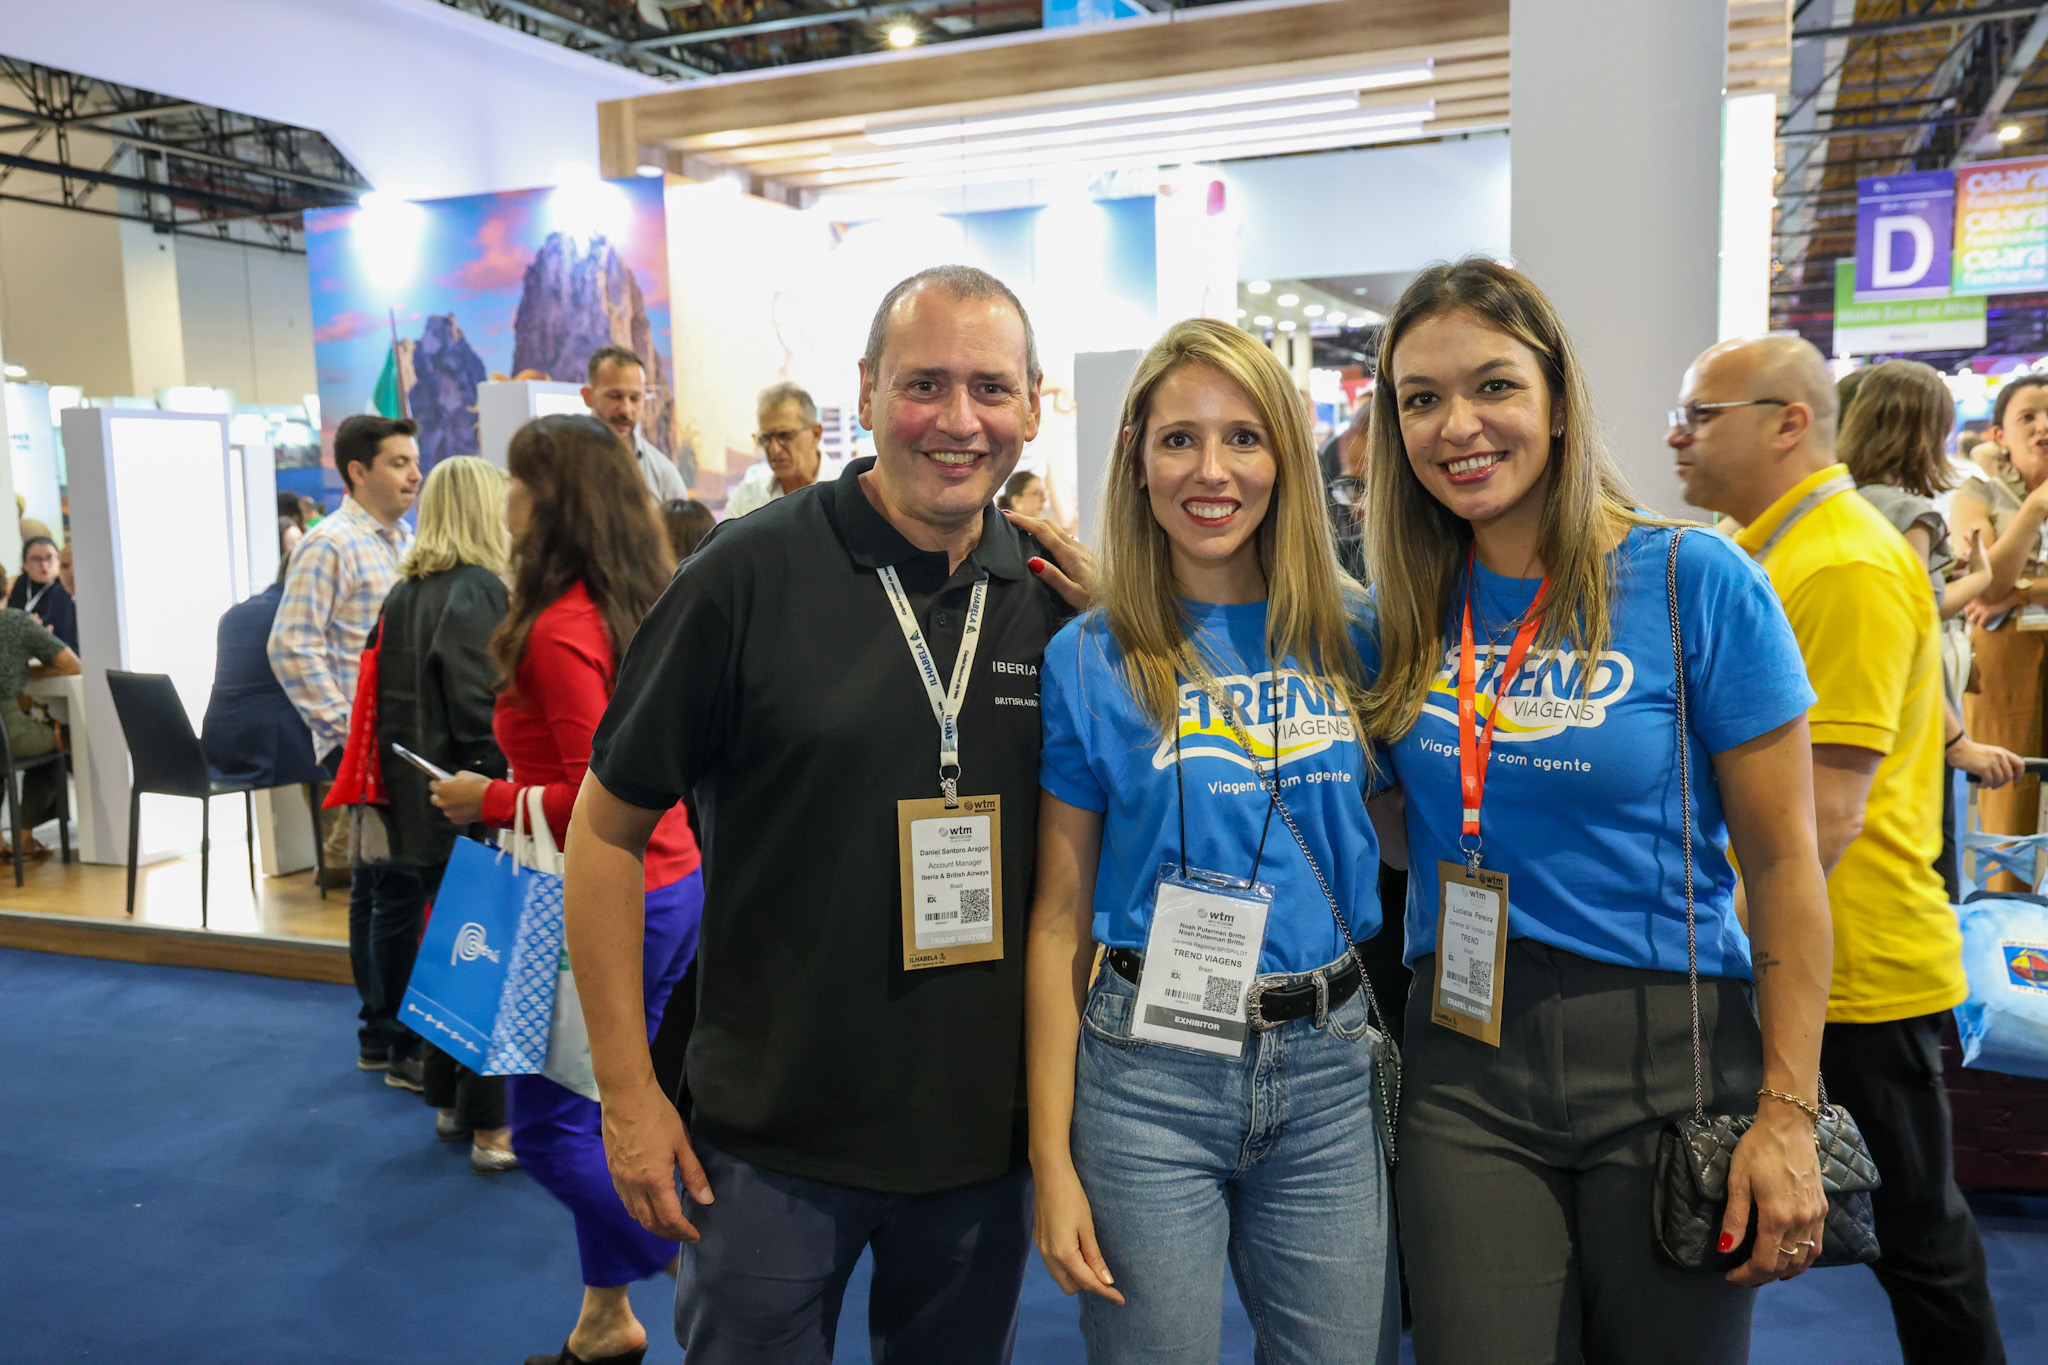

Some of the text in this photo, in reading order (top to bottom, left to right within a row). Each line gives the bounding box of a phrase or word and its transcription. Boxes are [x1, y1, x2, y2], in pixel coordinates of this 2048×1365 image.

[1872, 215, 1934, 289] D
[969, 585, 982, 623] ILHABELA
[915, 642, 938, 686] ILHABELA
[992, 660, 1038, 676] IBERIA
[994, 696, 1023, 706] BRITISH
[1514, 701, 1595, 721] VIAGENS
[1268, 719, 1350, 740] VIAGENS
[1420, 738, 1460, 758] Viage
[1498, 753, 1528, 765] com
[1533, 757, 1592, 772] agente
[1208, 780, 1257, 795] Viagem
[1305, 769, 1351, 784] agente
[974, 799, 996, 809] wtm
[949, 826, 972, 835] wtm
[941, 847, 966, 855] Santoro
[967, 845, 989, 853] Aragon
[928, 859, 983, 869] Account Manager
[921, 873, 939, 881] Iberia
[946, 871, 965, 879] British
[966, 869, 989, 877] Airways
[1486, 875, 1504, 886] wtm
[1469, 889, 1486, 900] wtm
[1210, 911, 1235, 923] wtm
[1453, 906, 1493, 923] Luciana Pereira
[931, 933, 987, 944] TRADE VISITOR
[1178, 929, 1245, 947] Noah Puterman Britto
[1179, 922, 1196, 931] Noah
[1197, 926, 1227, 937] Puterman
[1228, 931, 1246, 940] Britto
[1461, 933, 1479, 945] TREND
[1172, 937, 1193, 946] Gerente
[1193, 941, 1217, 950] Regional
[909, 954, 938, 963] ILHABELA
[1173, 948, 1243, 968] TREND VIAGENS
[1447, 997, 1486, 1017] TRAVEL AGENT
[1174, 1015, 1220, 1031] EXHIBITOR
